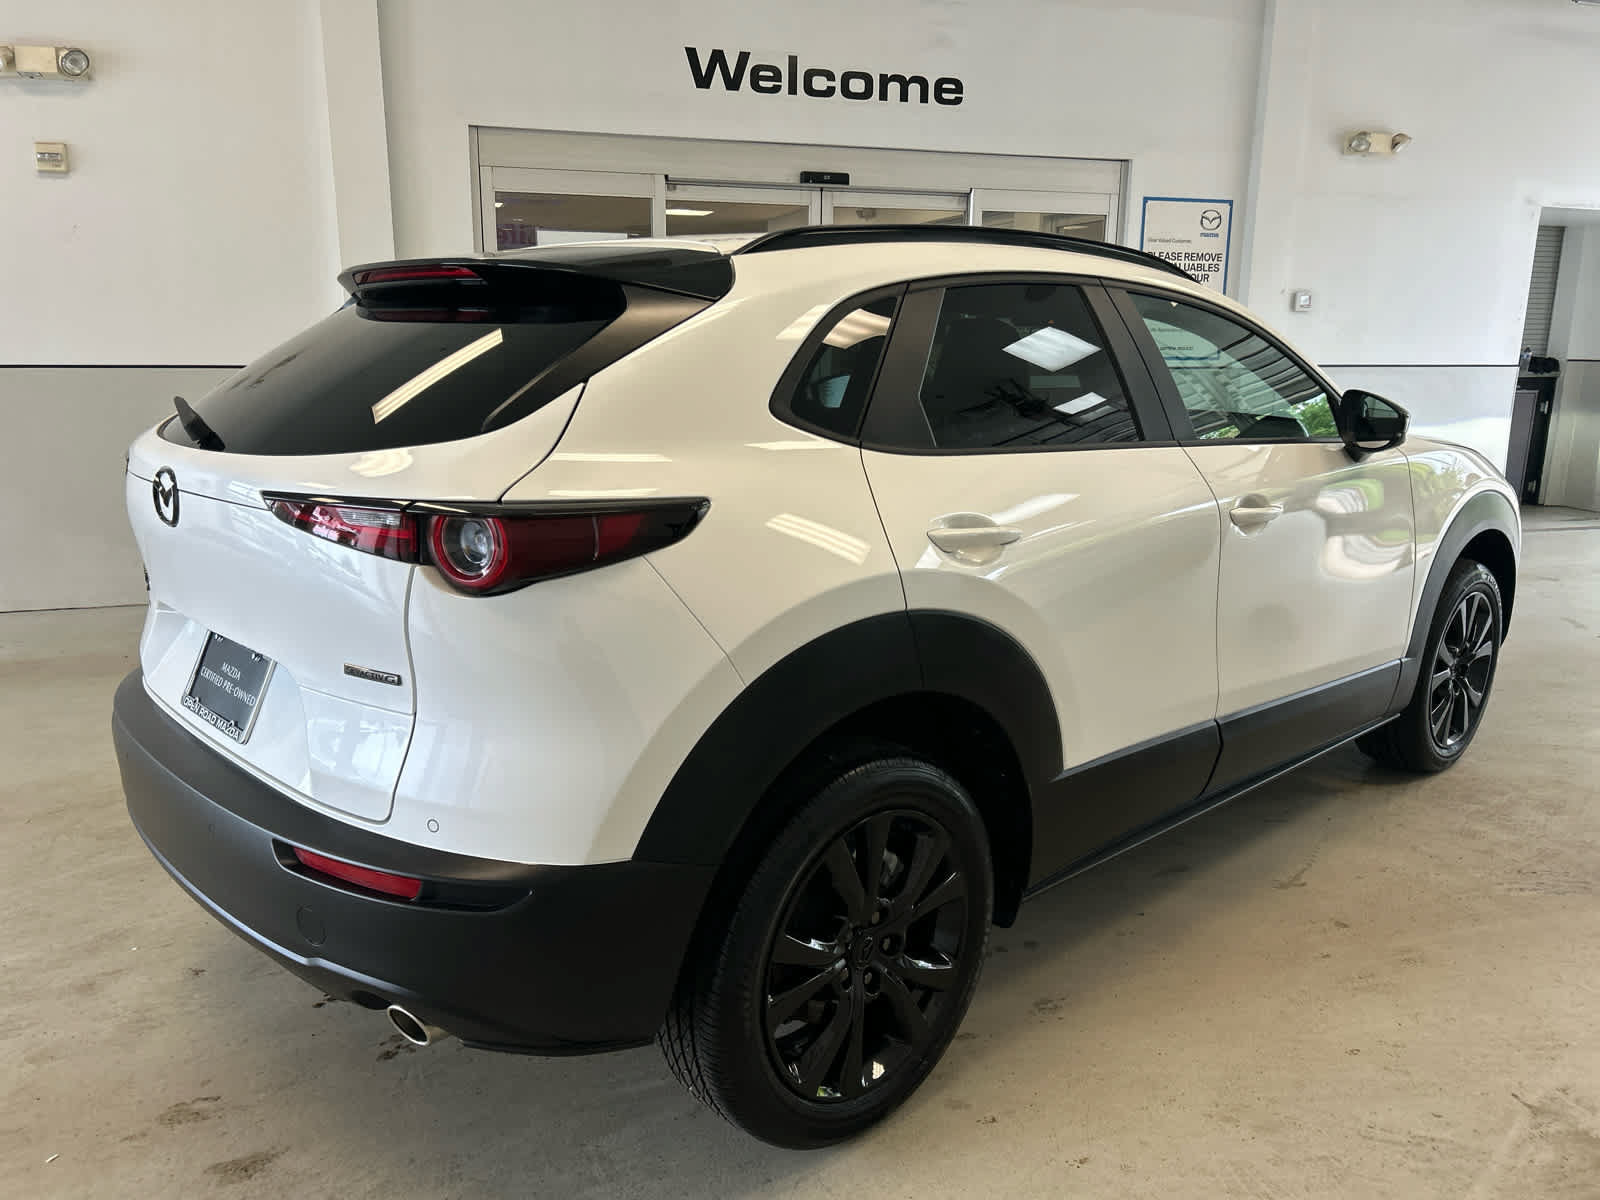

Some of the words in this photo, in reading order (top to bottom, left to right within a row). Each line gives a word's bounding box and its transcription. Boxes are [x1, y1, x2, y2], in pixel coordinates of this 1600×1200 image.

[684, 46, 963, 105] Welcome
[1184, 252, 1223, 262] REMOVE
[1174, 262, 1220, 272] UABLES
[1191, 272, 1210, 282] OUR
[222, 662, 240, 680] MAZDA
[201, 667, 222, 687] CERTIFIED
[222, 681, 256, 706] PRE-OWNED
[184, 697, 199, 712] OPEN
[200, 706, 216, 723] ROAD
[216, 719, 239, 739] MAZDA
